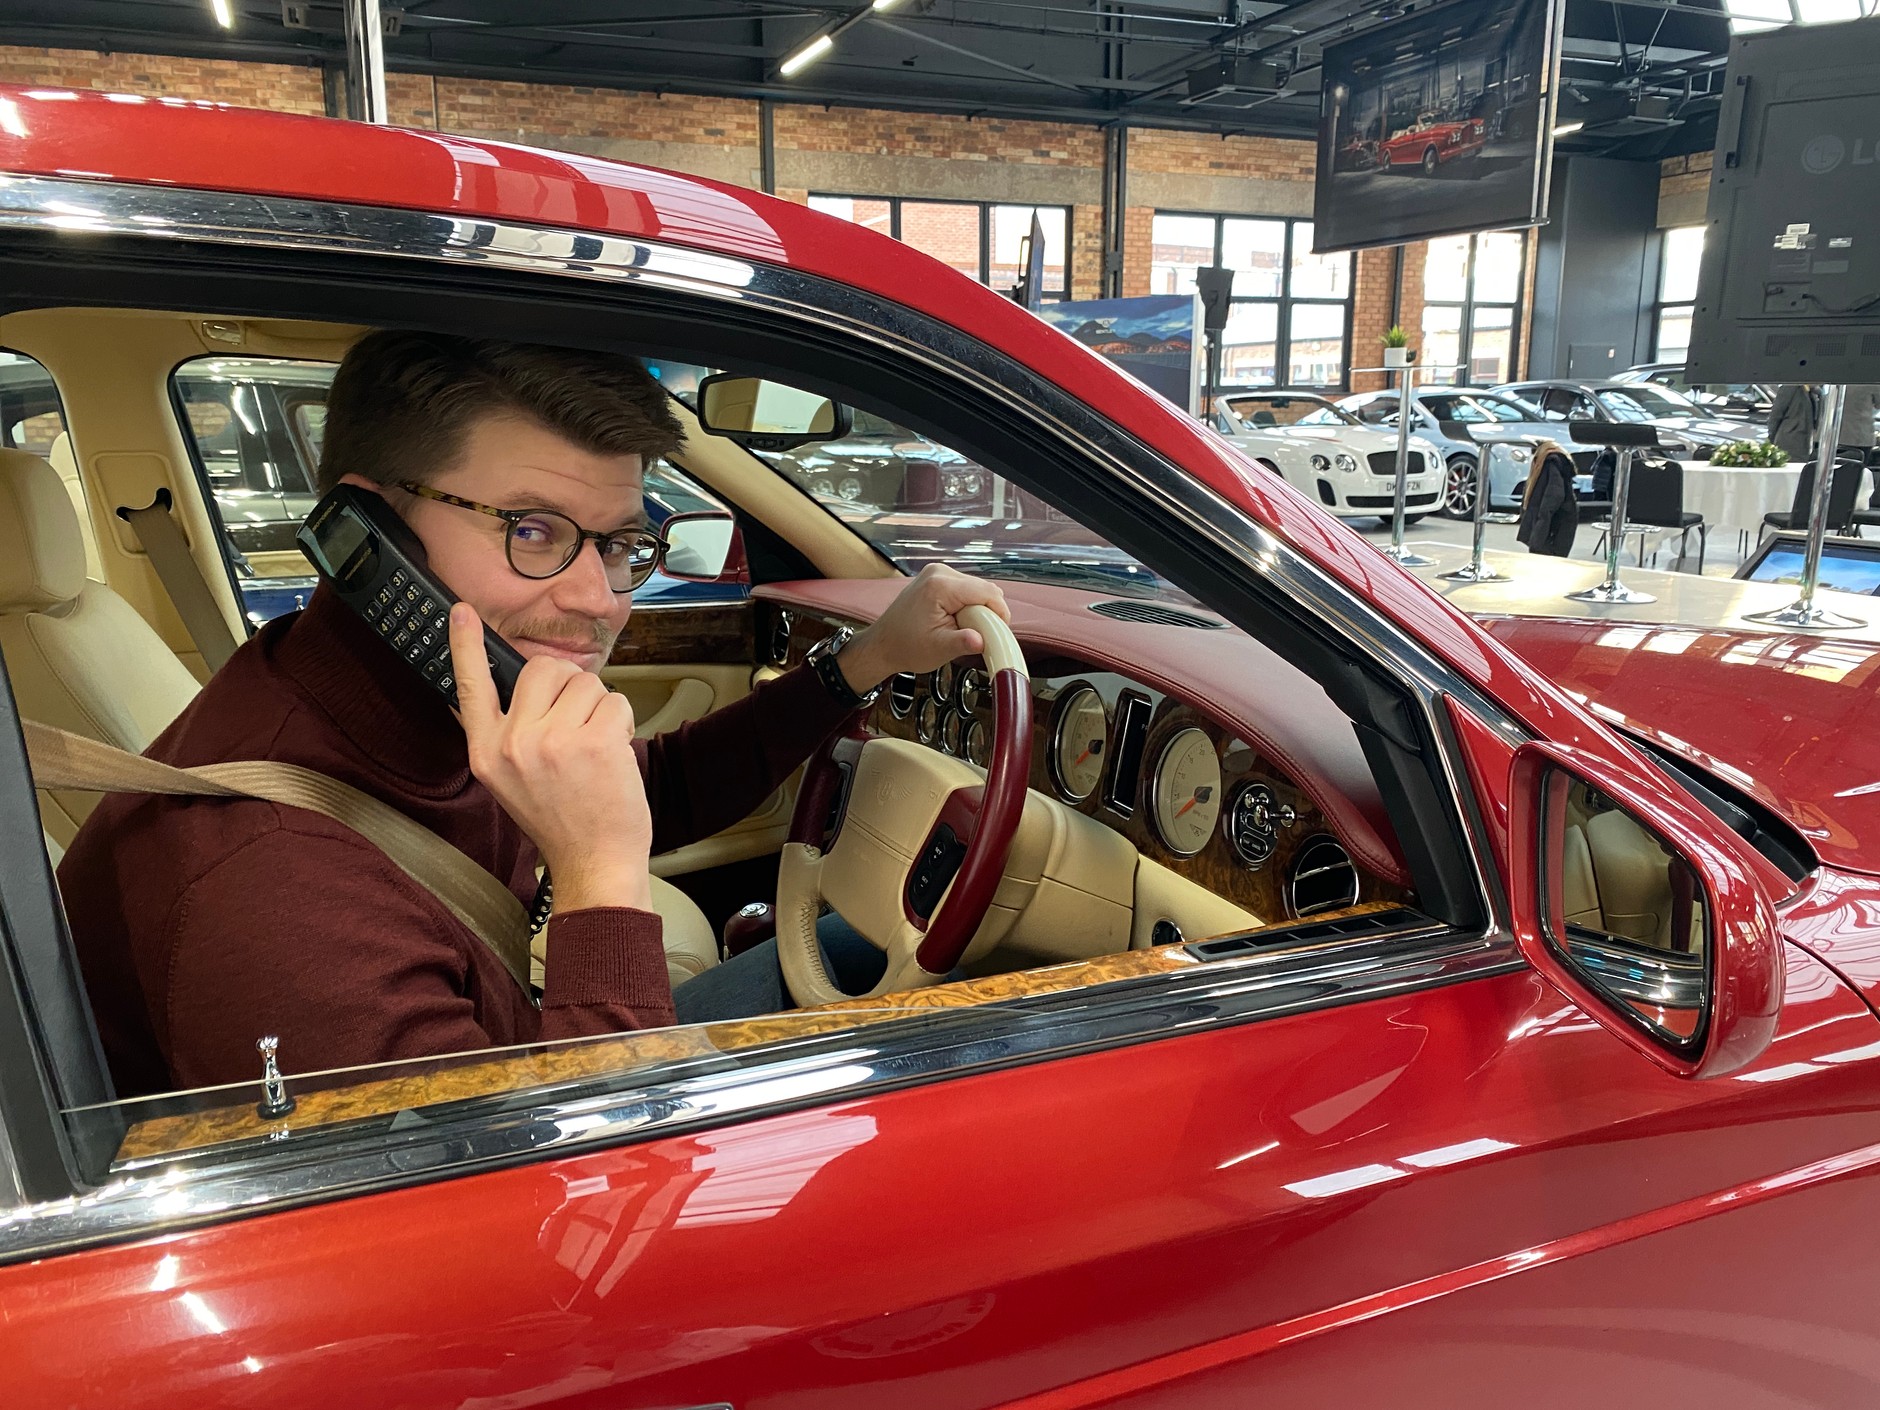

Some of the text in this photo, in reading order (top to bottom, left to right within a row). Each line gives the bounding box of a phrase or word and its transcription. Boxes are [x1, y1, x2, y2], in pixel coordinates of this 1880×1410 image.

[393, 576, 401, 586] 3
[380, 592, 388, 603] 2
[406, 591, 415, 601] 6
[368, 608, 375, 617] 1
[393, 607, 401, 617] 5
[420, 605, 429, 615] 9
[381, 622, 388, 632] 4
[407, 621, 416, 631] 8
[394, 636, 401, 646] 7
